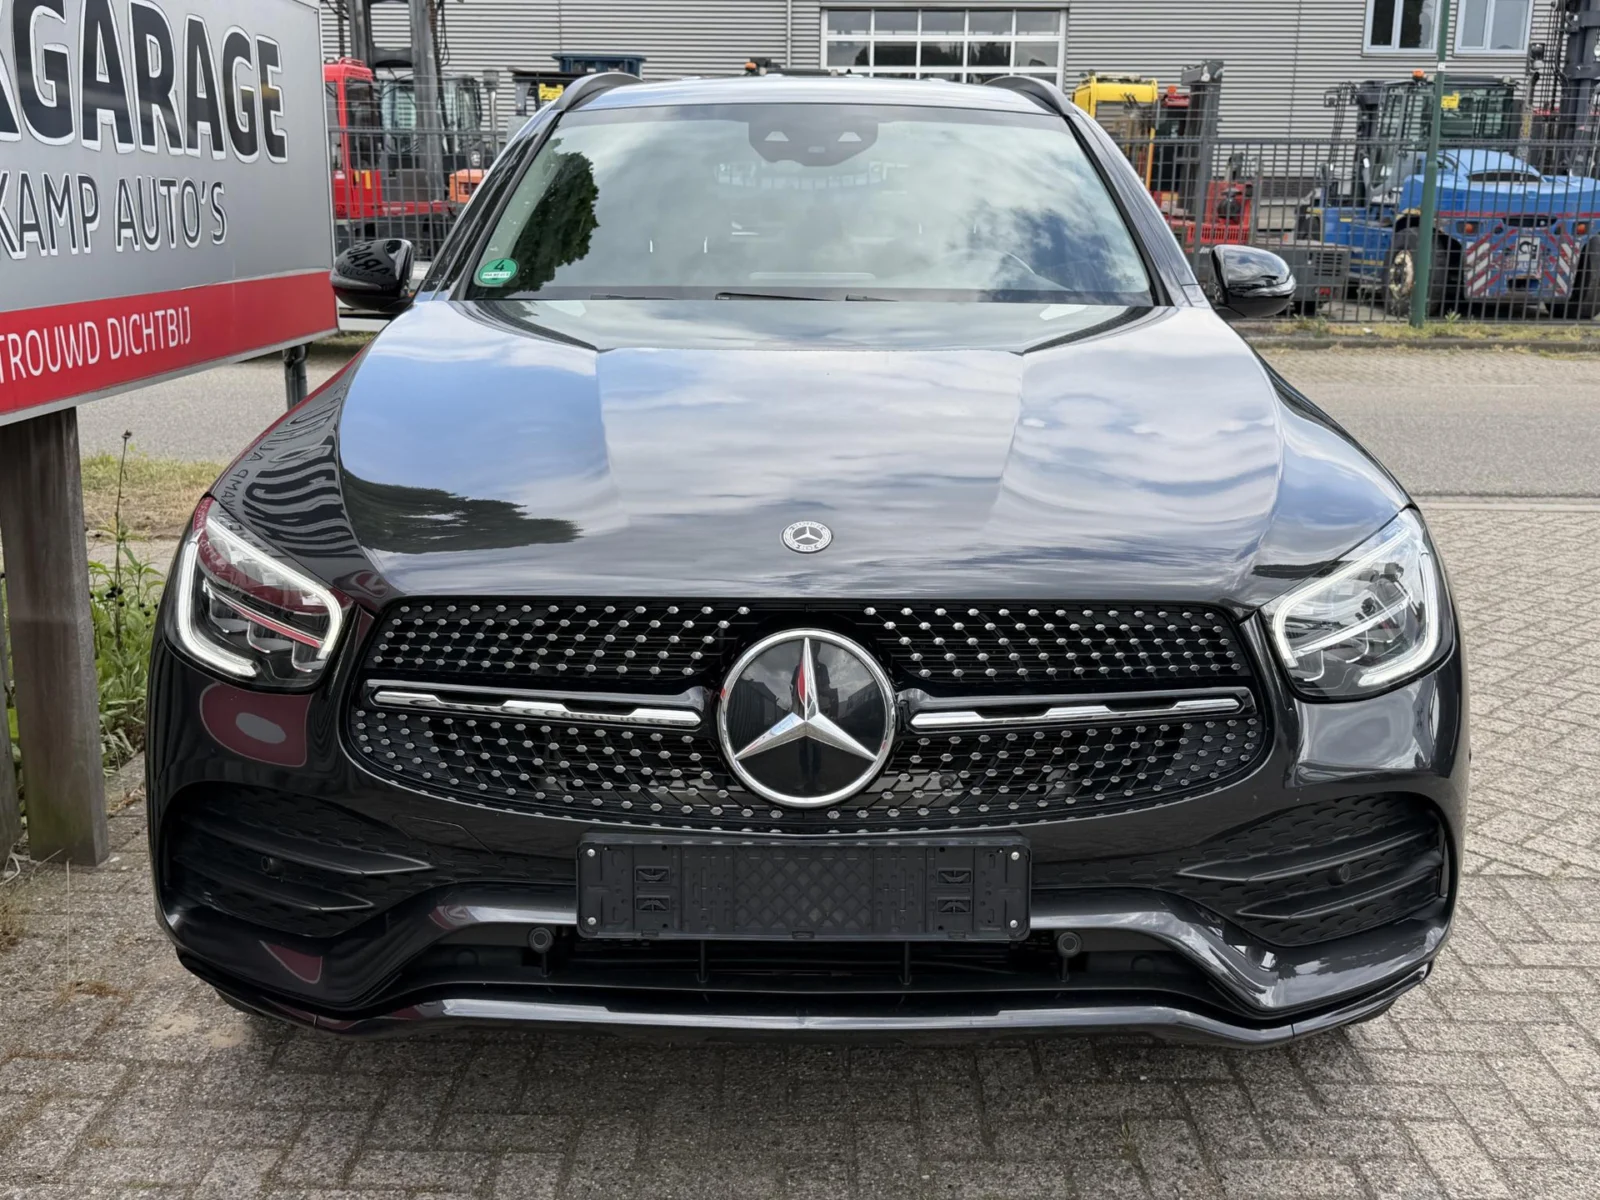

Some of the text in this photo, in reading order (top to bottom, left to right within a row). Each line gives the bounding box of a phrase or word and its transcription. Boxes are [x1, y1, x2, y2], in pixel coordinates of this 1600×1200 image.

[0, 0, 289, 164] GARAGE
[114, 175, 228, 252] AUTO'S
[494, 259, 505, 271] 4
[106, 306, 191, 360] DICHTBIJ
